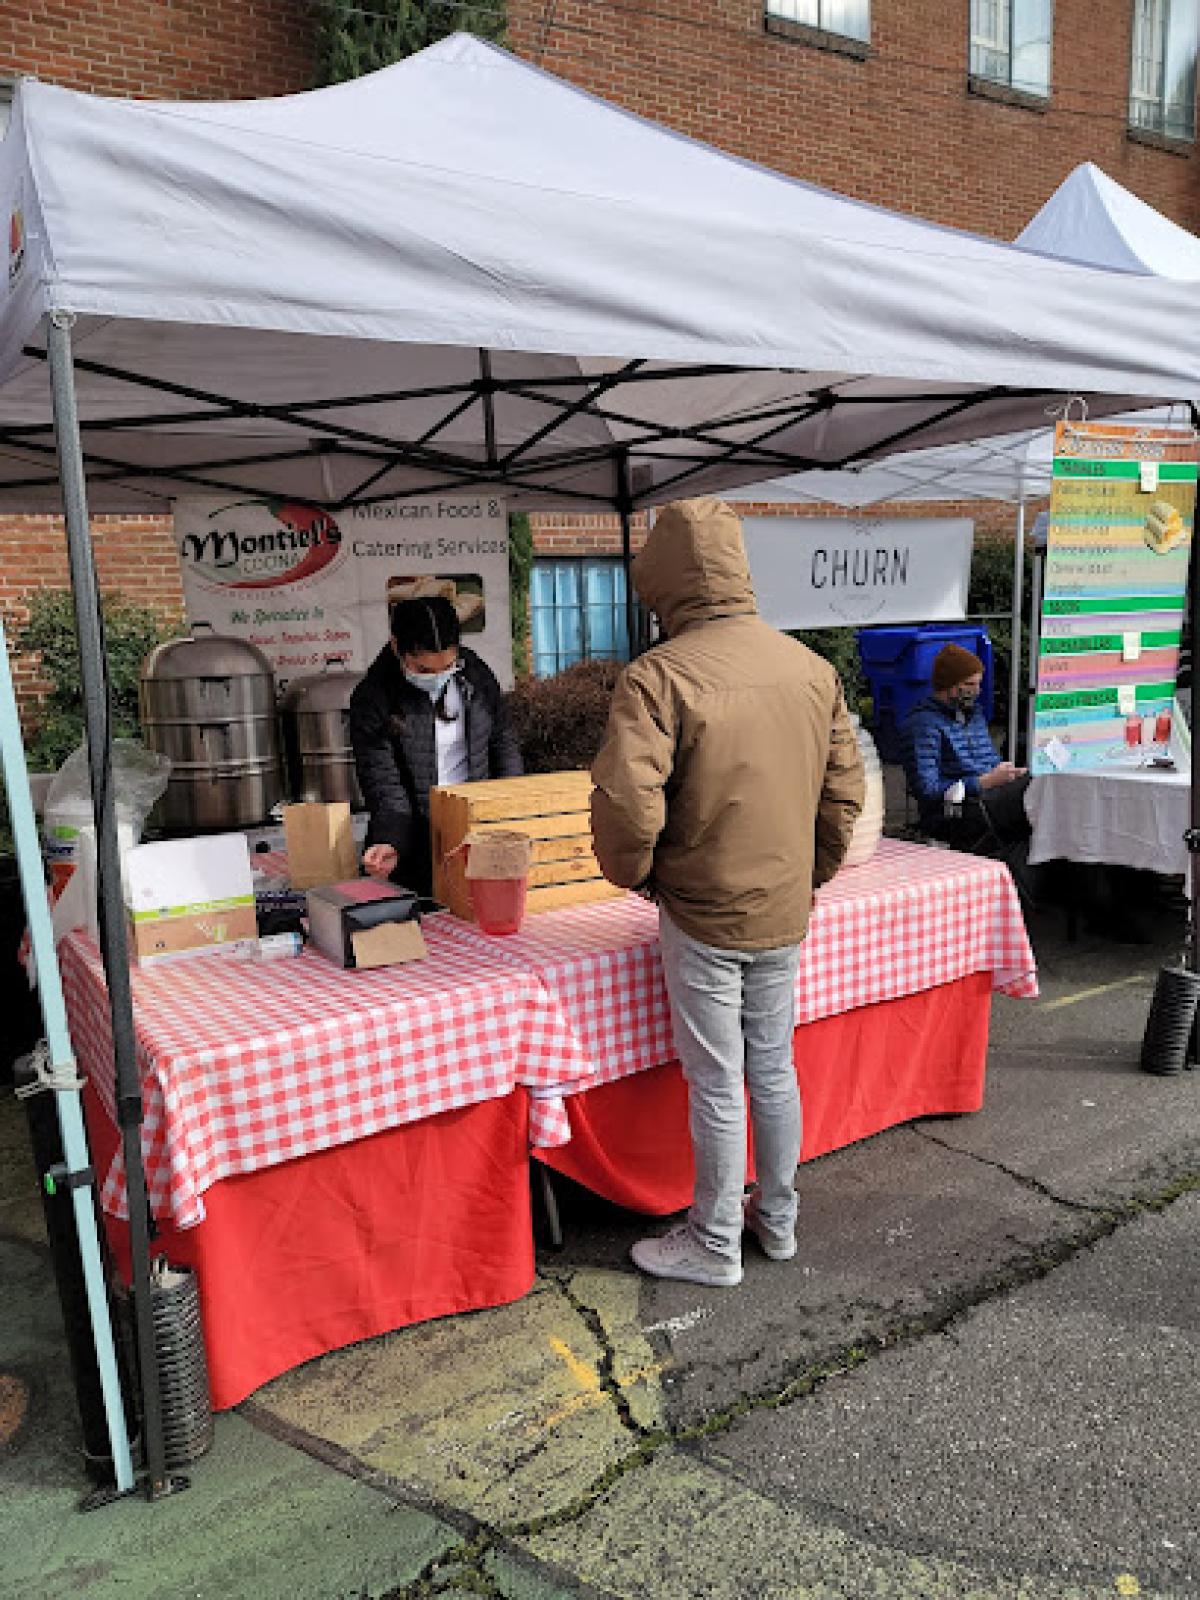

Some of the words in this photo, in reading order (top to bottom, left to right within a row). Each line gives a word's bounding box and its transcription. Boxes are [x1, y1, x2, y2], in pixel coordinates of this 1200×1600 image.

[352, 500, 431, 519] Mexican
[437, 500, 482, 519] Food
[488, 499, 500, 519] &
[182, 517, 342, 567] Montiel's
[352, 539, 433, 560] Catering
[437, 536, 508, 557] Services
[811, 547, 910, 589] CHURN
